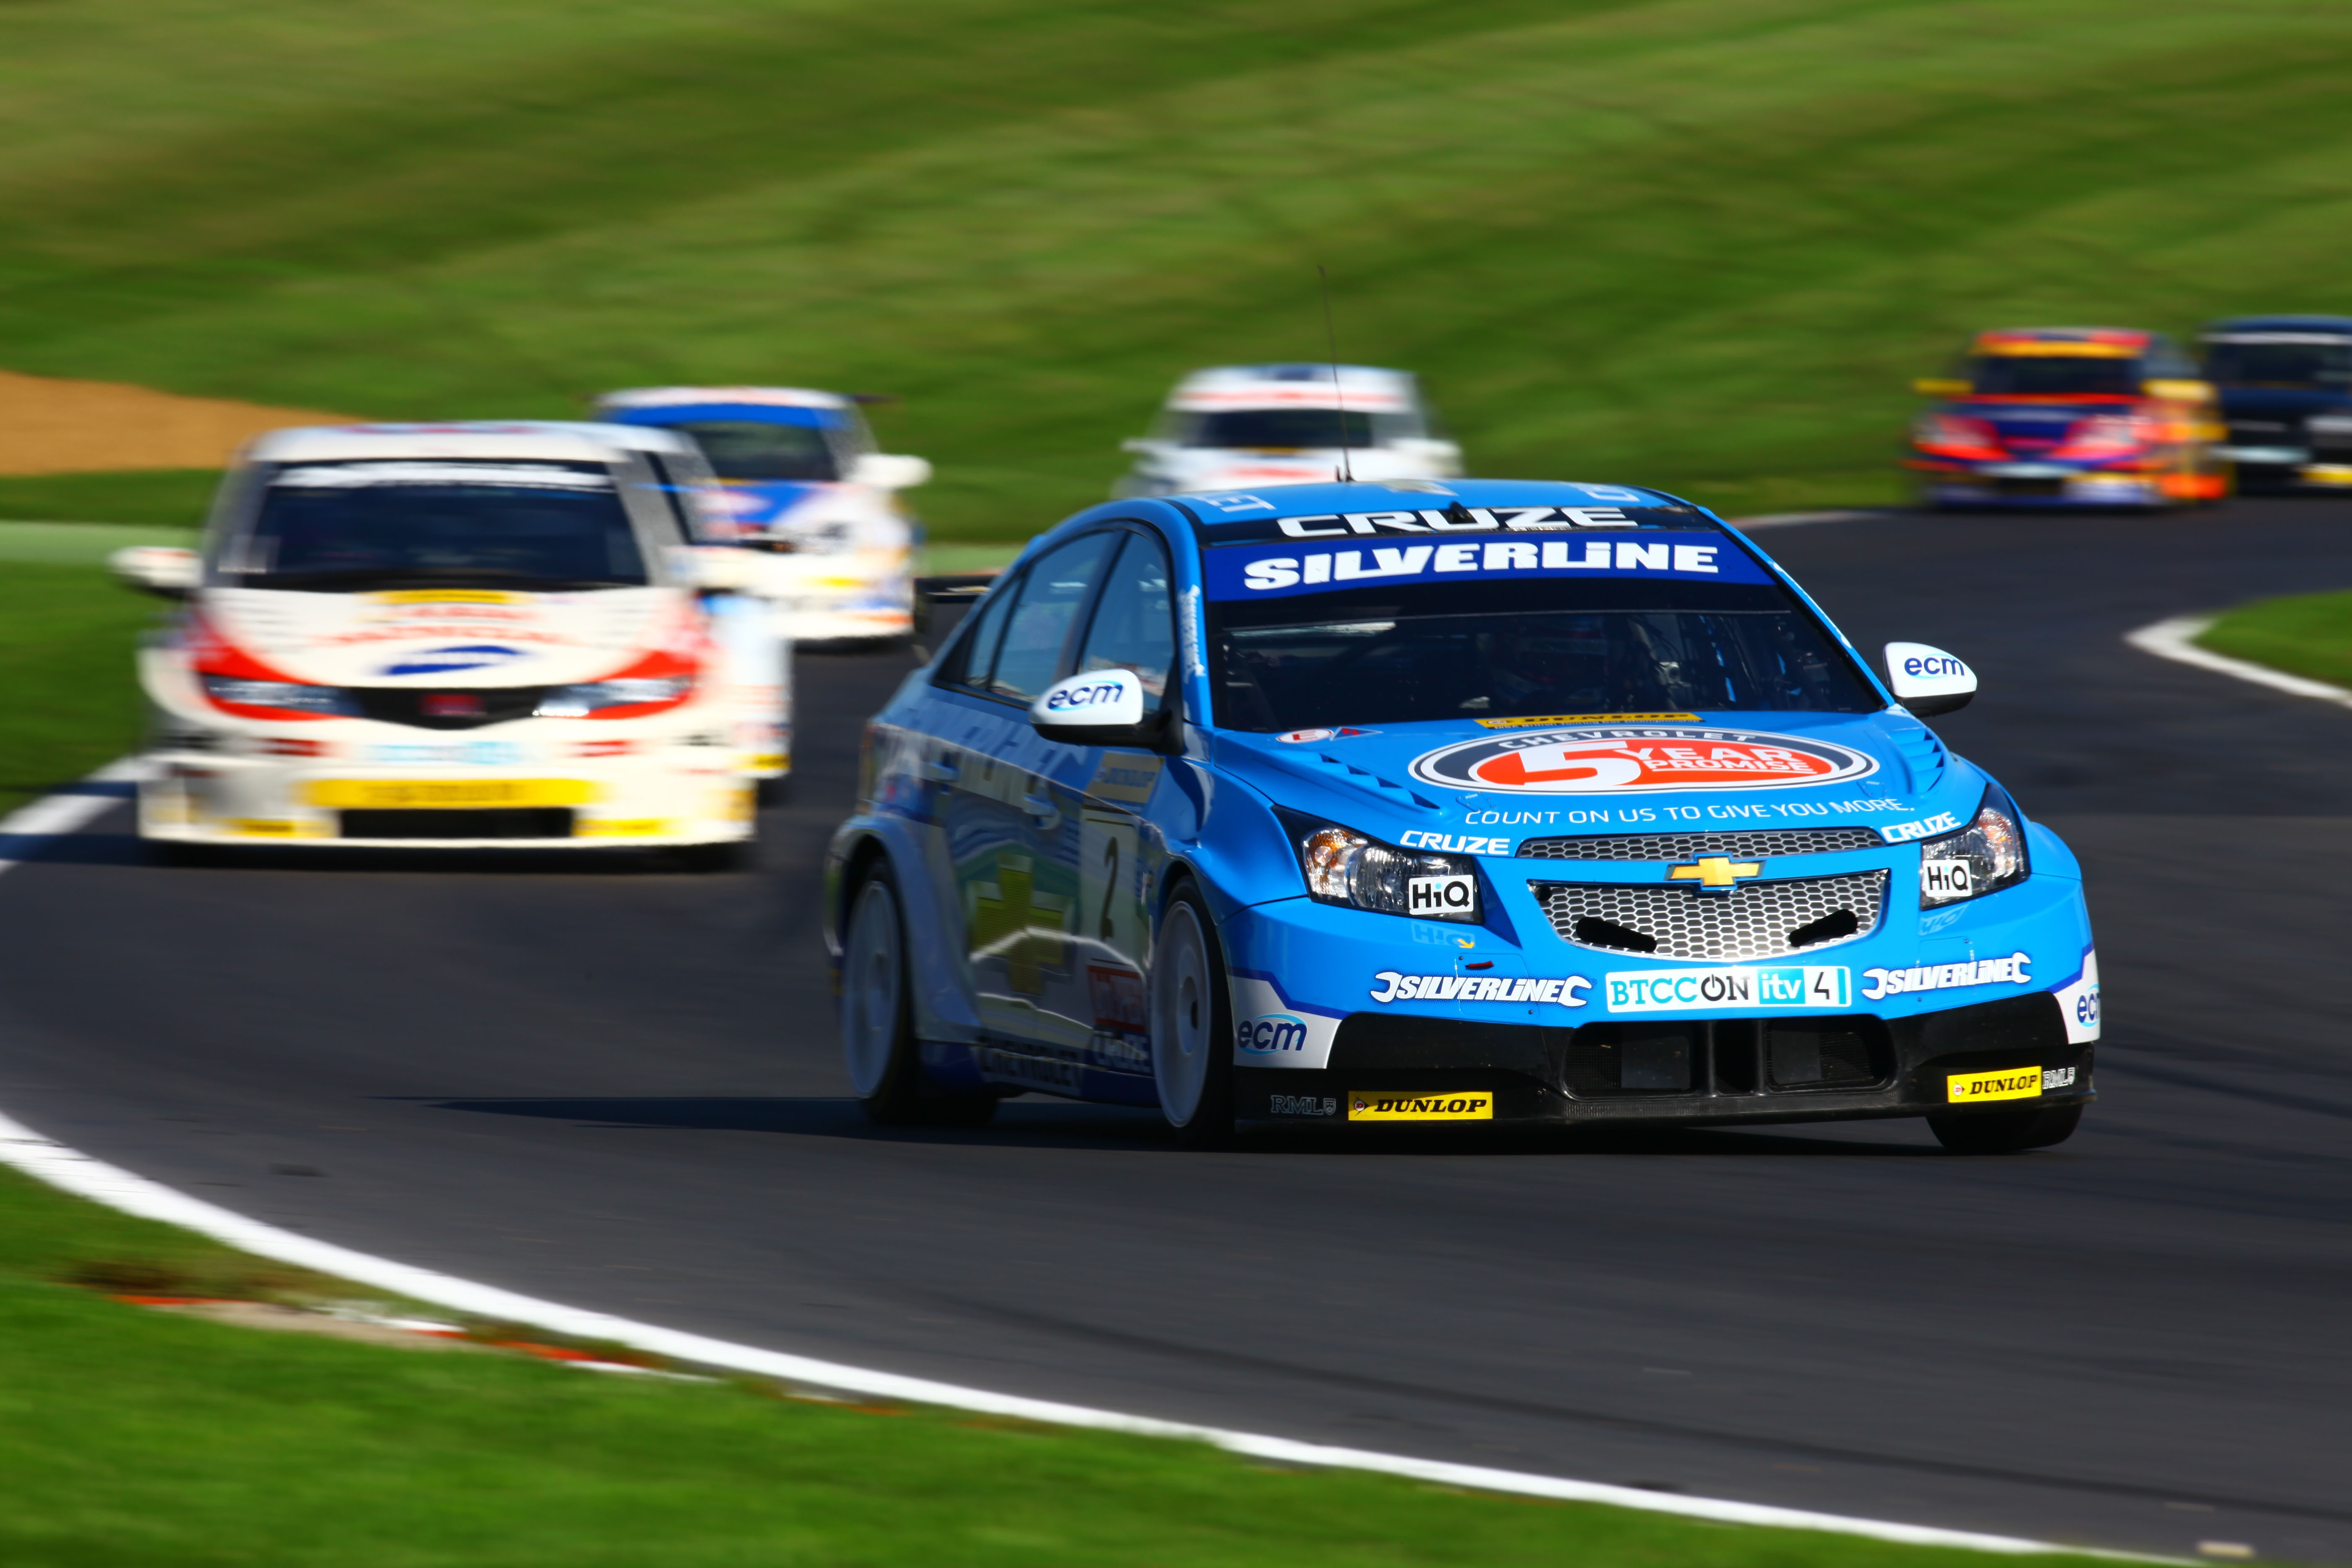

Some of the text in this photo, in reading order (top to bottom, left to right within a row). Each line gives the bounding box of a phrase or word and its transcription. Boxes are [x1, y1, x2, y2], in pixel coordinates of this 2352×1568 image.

[1277, 506, 1639, 537] CRUZE
[1904, 657, 1965, 677] ecm
[1047, 684, 1123, 709] ecm
[1499, 730, 1755, 749] CHEVROLET
[1519, 740, 1641, 791] 5
[1612, 748, 1794, 762] YEAR
[1643, 759, 1811, 772] PROMISE
[1465, 798, 1915, 825] COUNT ON US TO GIVE YOU MORE.
[1880, 812, 1962, 843] CRUZE
[1400, 830, 1510, 855] CRUZE
[1927, 864, 1969, 891] HiQ
[1412, 880, 1470, 909] HiQ
[1761, 973, 1801, 999] itv
[1813, 972, 1830, 1000] 4
[1237, 1019, 1308, 1051] ecm
[1969, 1074, 2038, 1095] DUNLOP
[1271, 1094, 1324, 1115] RML
[1374, 1099, 1487, 1113] DUNLOP
